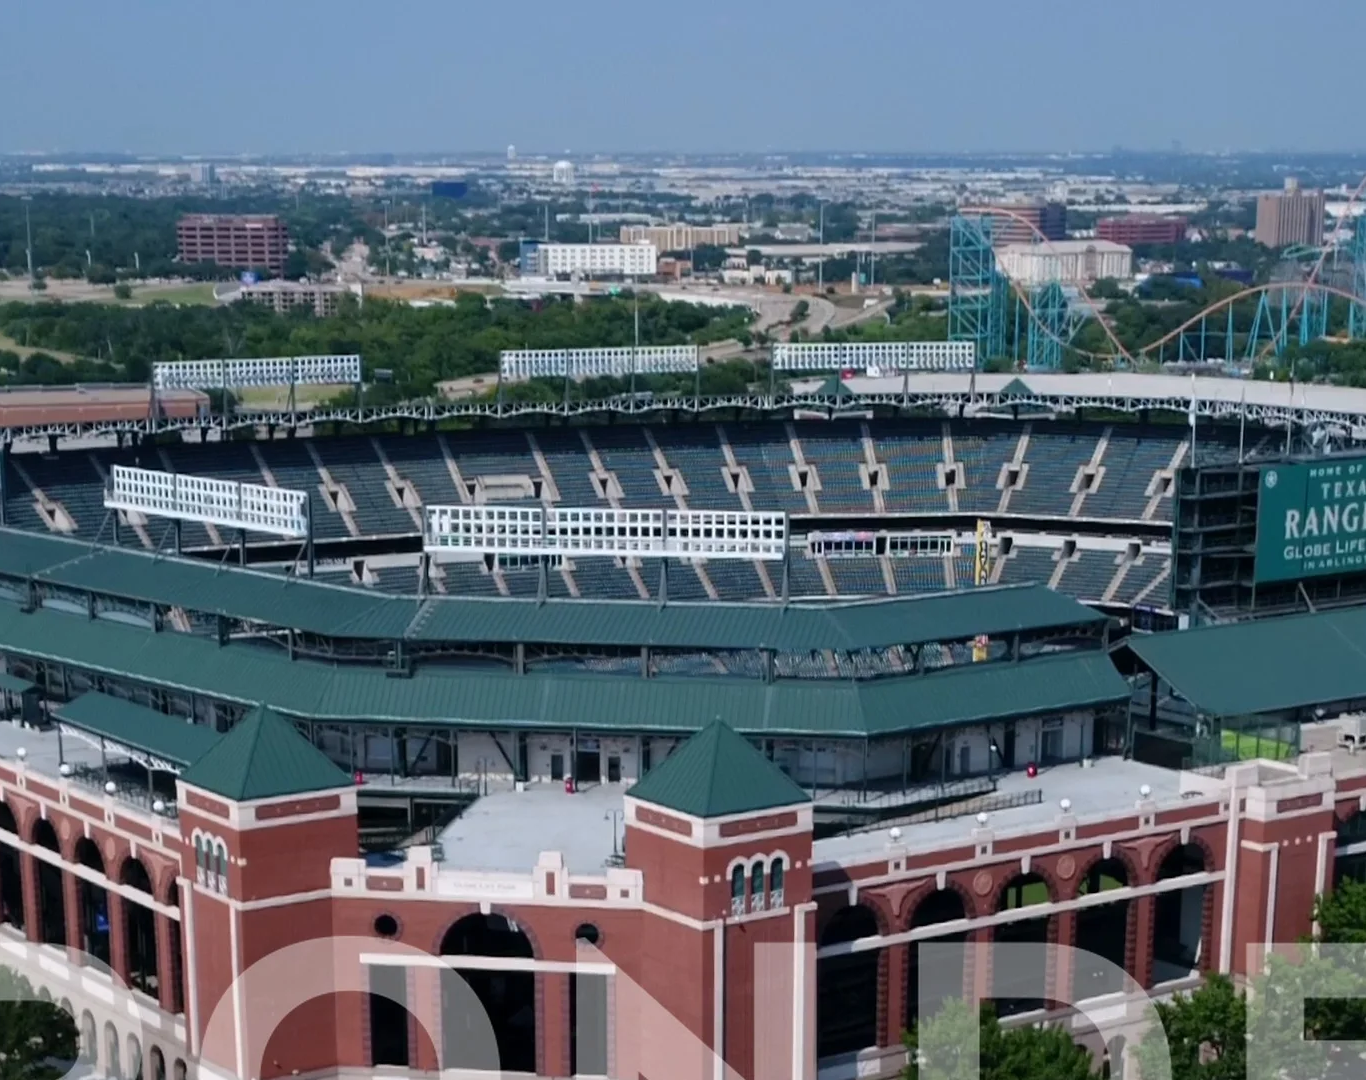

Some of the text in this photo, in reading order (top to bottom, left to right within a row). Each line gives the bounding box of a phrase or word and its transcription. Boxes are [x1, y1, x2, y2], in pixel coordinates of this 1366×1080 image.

[1310, 466, 1342, 477] HOME
[1348, 464, 1363, 474] OF
[1284, 542, 1331, 560] GLOBE
[1336, 538, 1366, 554] LIFE
[1303, 560, 1315, 570] IN
